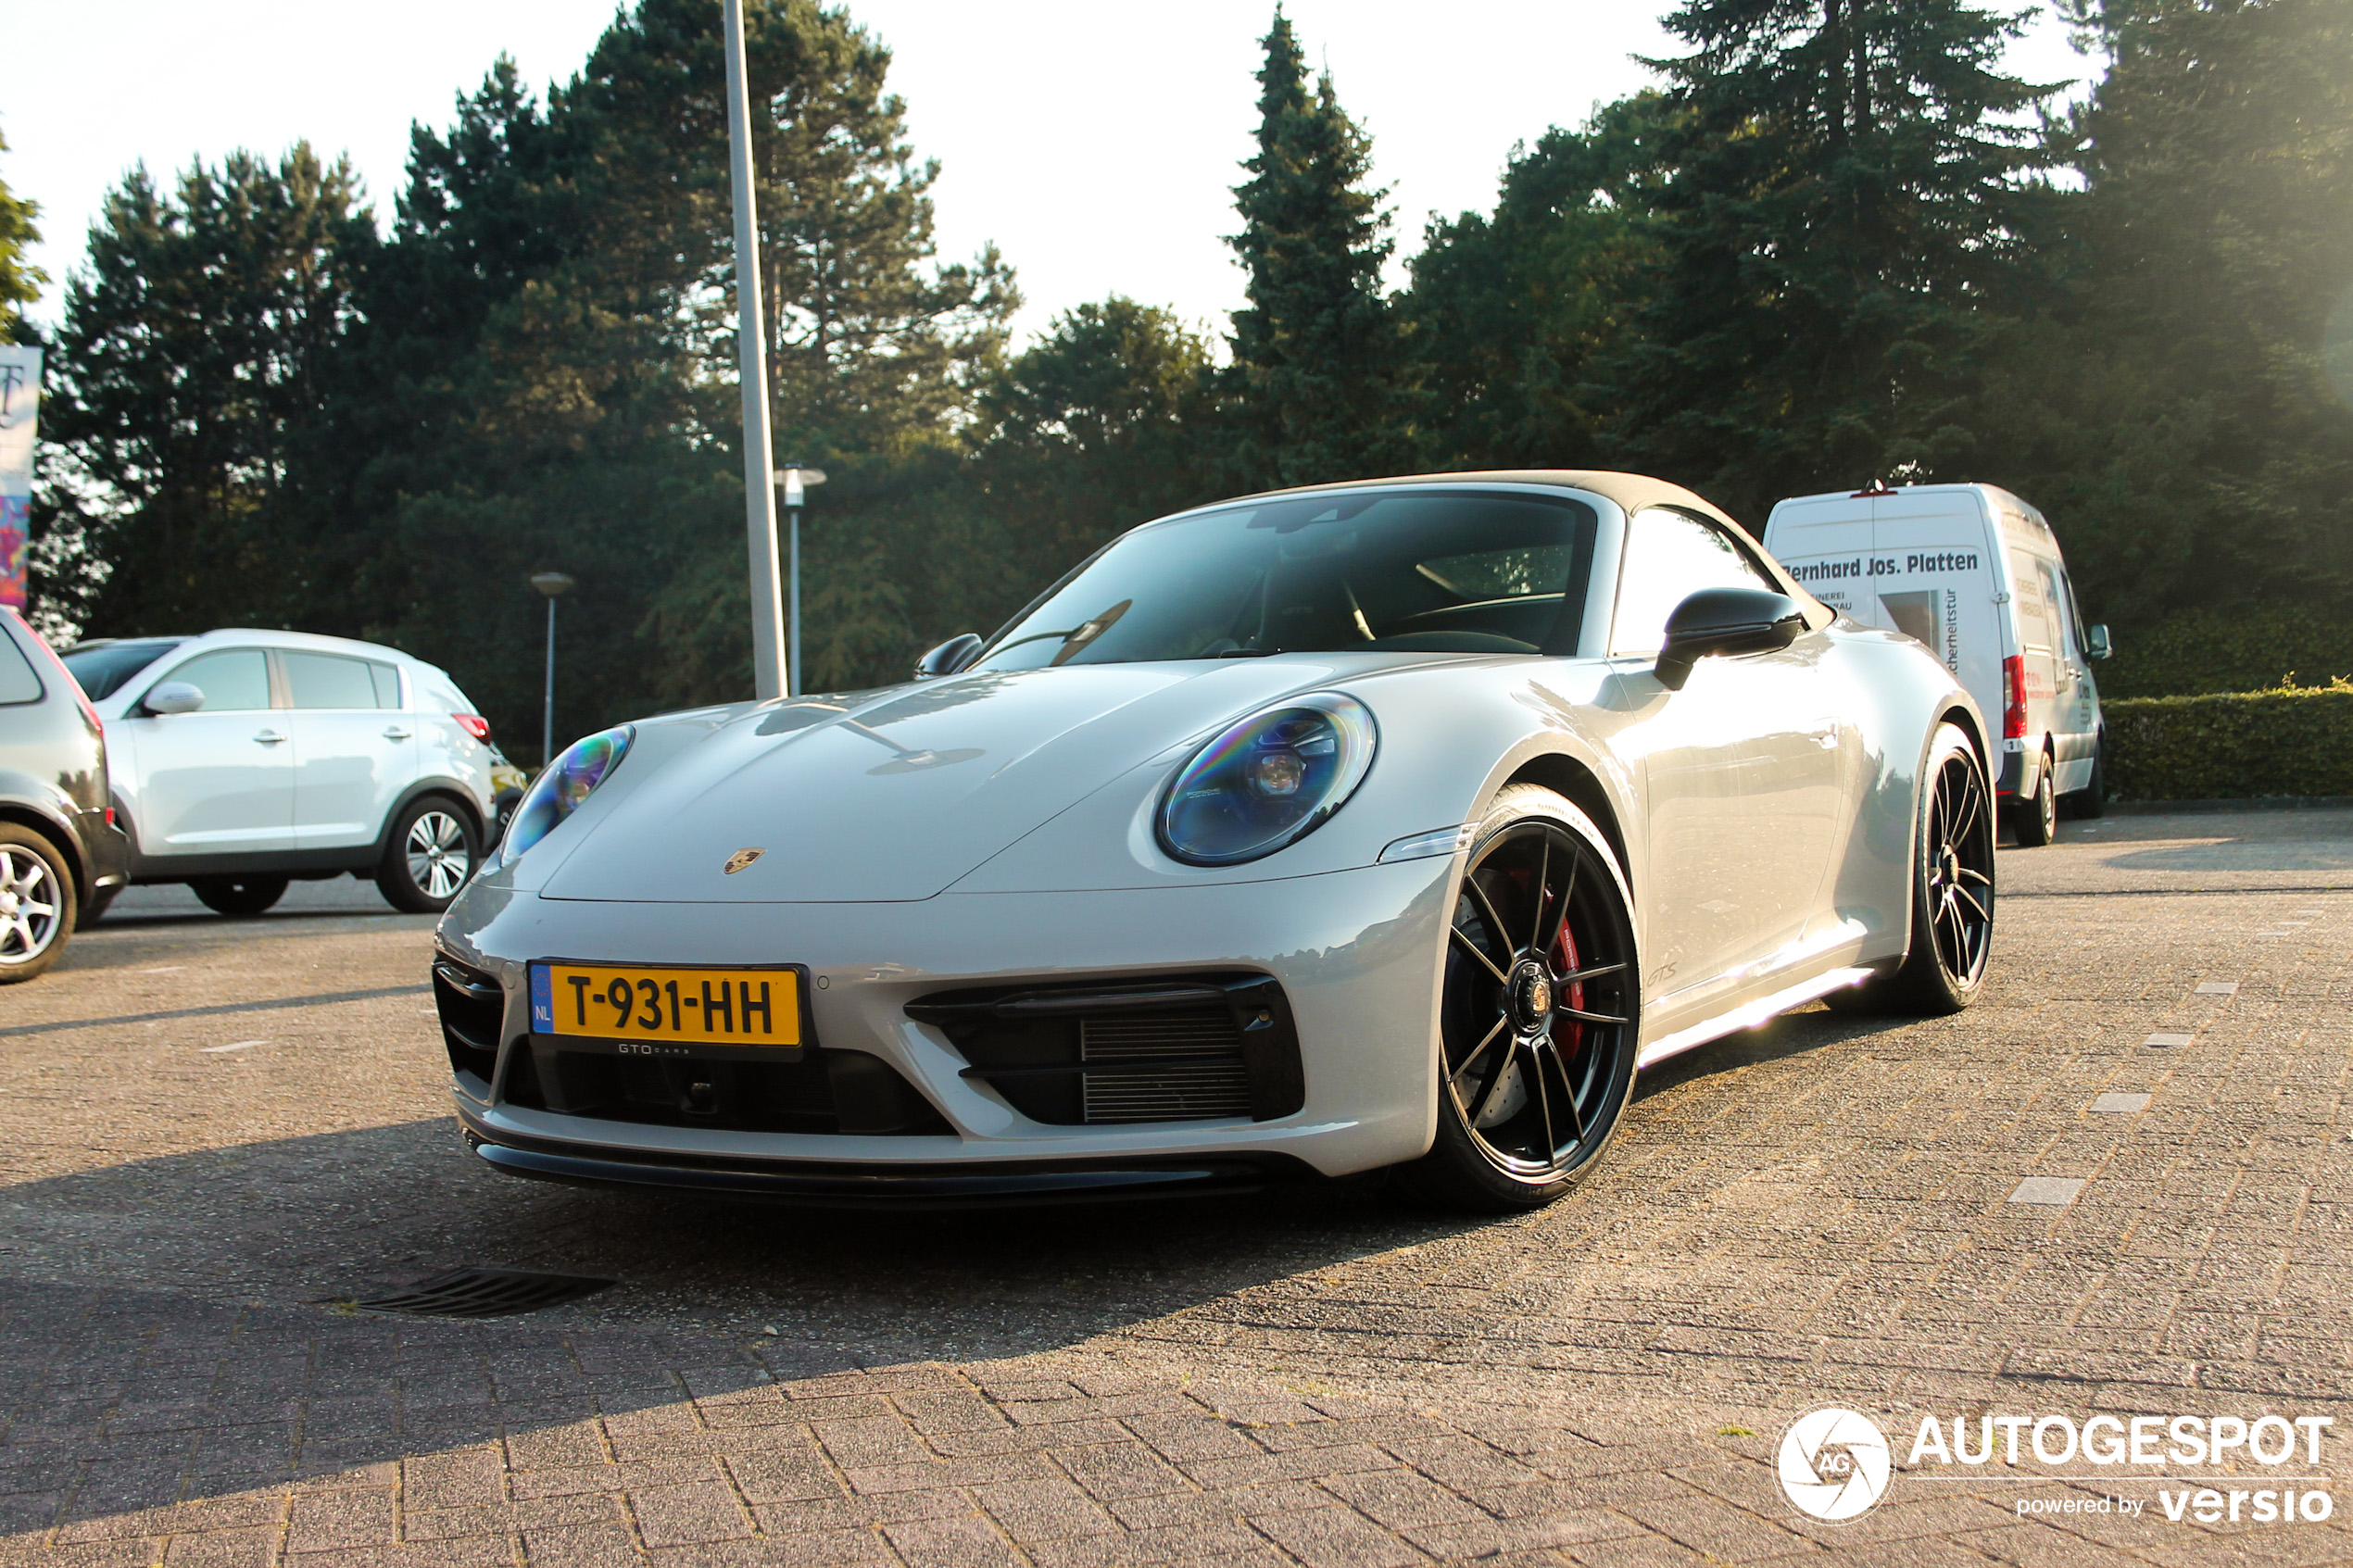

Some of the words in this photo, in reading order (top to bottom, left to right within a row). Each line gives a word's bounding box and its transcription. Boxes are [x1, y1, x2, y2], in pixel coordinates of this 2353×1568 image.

[1867, 558, 1900, 576] Jos.
[1907, 553, 1978, 573] Platten
[1647, 962, 1677, 987] GTS
[535, 1005, 550, 1022] NL
[567, 975, 772, 1034] T-931-HH
[619, 1044, 651, 1055] GTO
